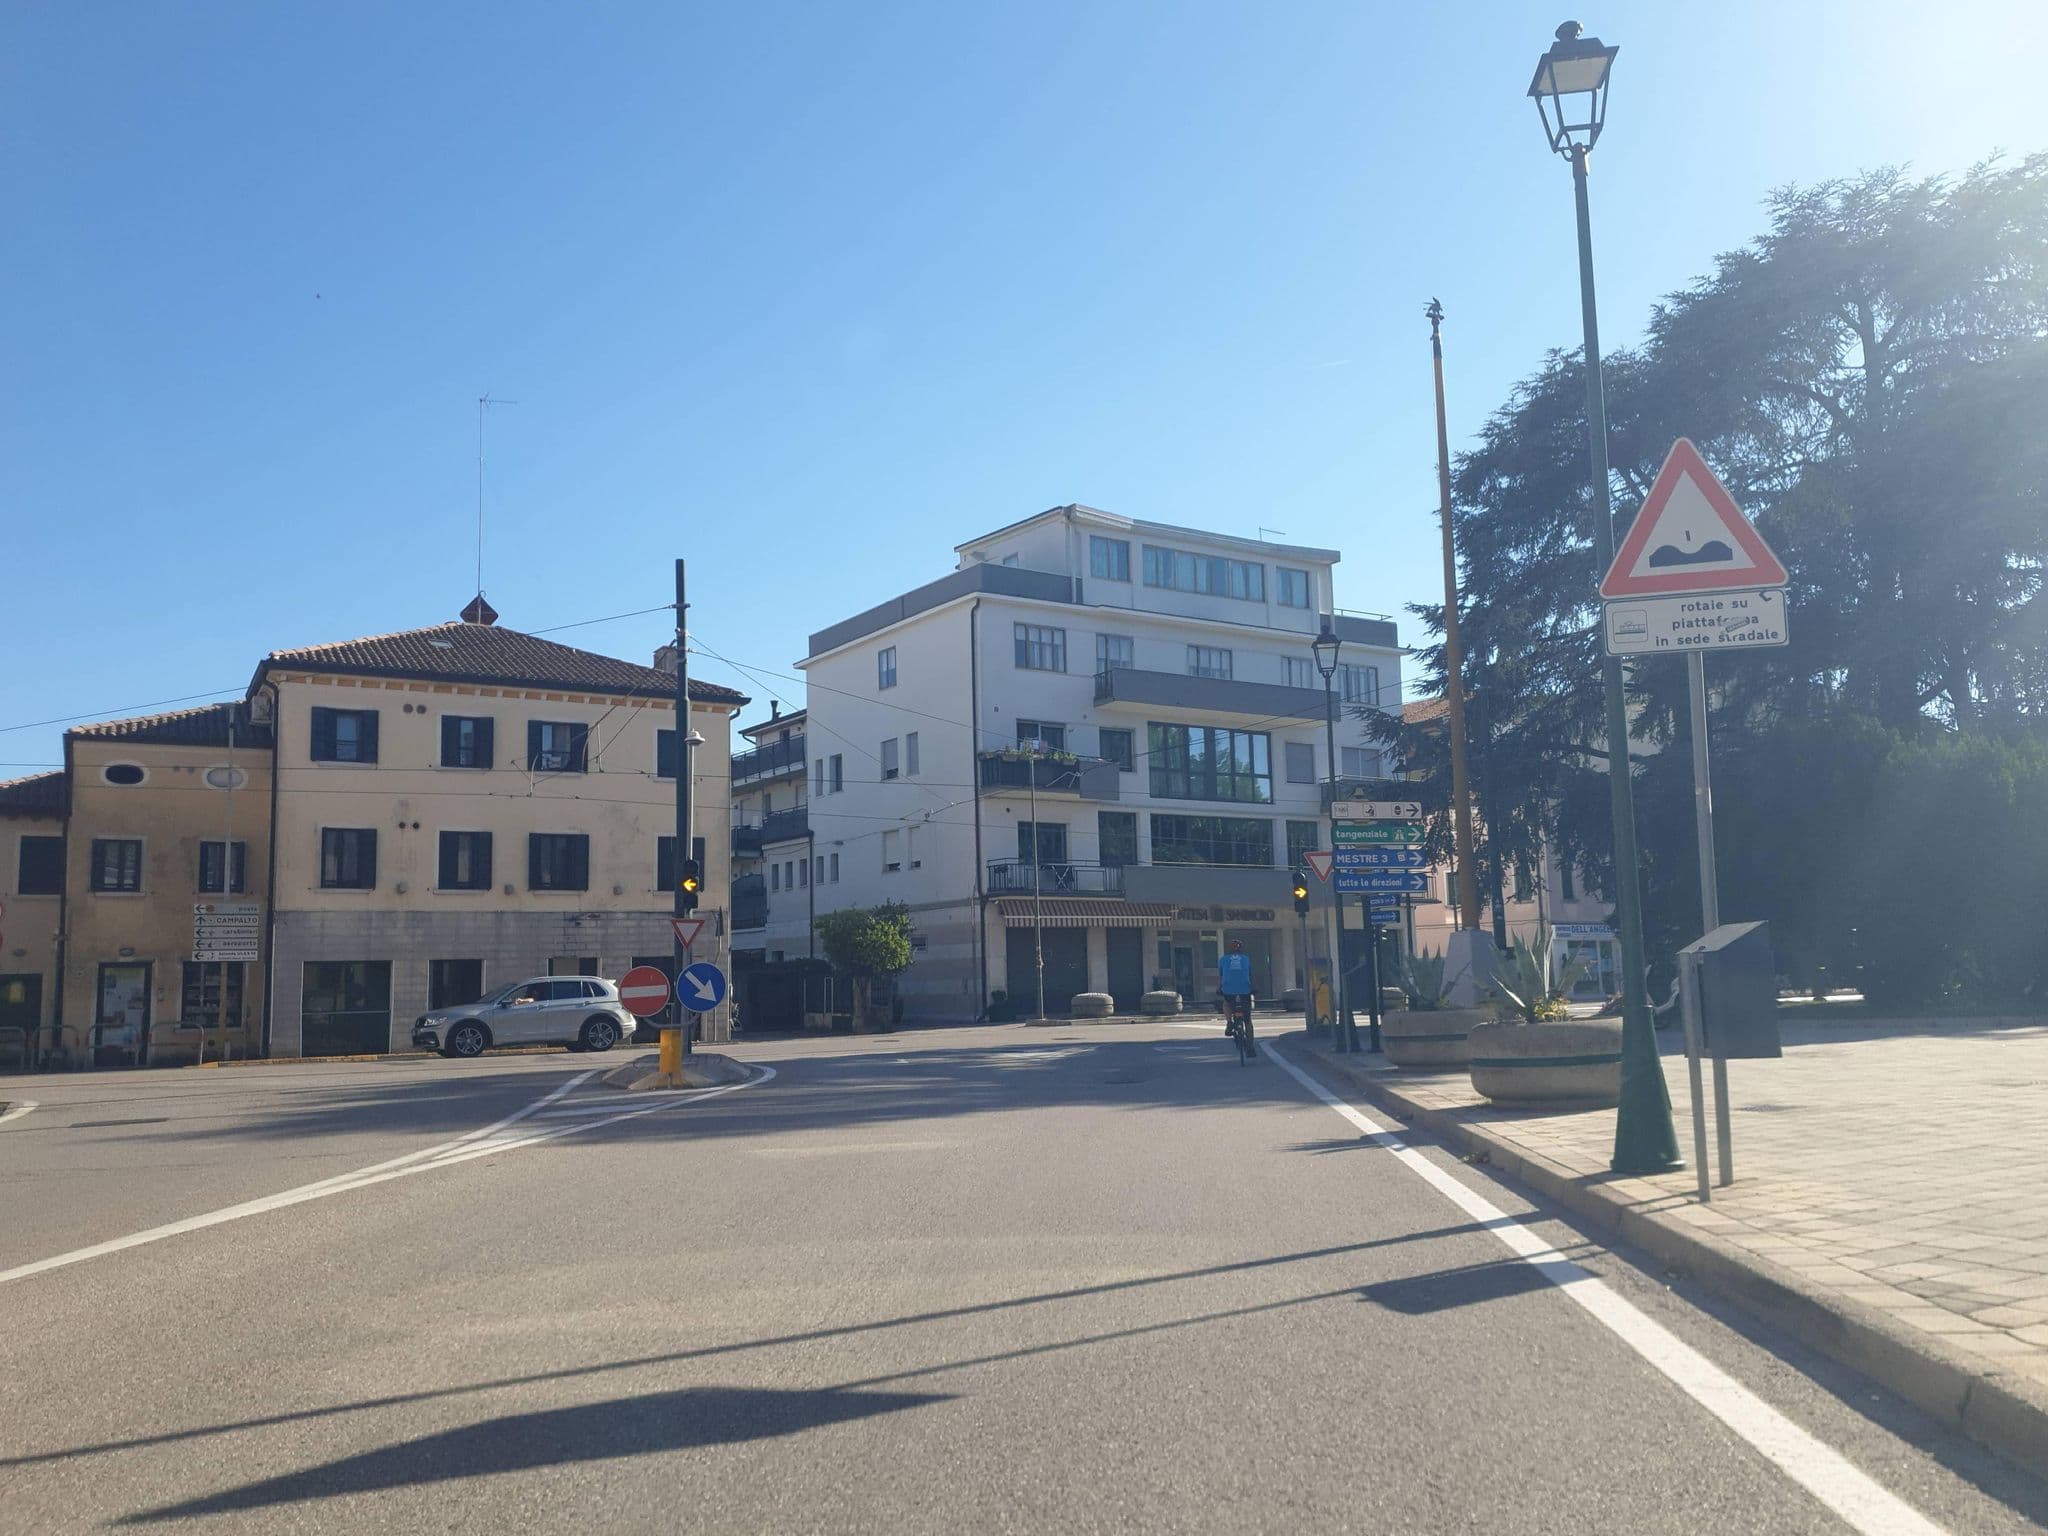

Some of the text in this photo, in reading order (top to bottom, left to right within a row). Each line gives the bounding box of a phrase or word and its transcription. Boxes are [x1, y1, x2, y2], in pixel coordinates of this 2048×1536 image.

[1681, 600, 1748, 612] rotaie su
[1672, 615, 1760, 631] piattafa
[1655, 629, 1778, 647] in sede stradale
[1336, 829, 1389, 840] tangenziale
[1336, 854, 1388, 864] MESTRE 3
[1339, 878, 1403, 888] tutte le direzioni
